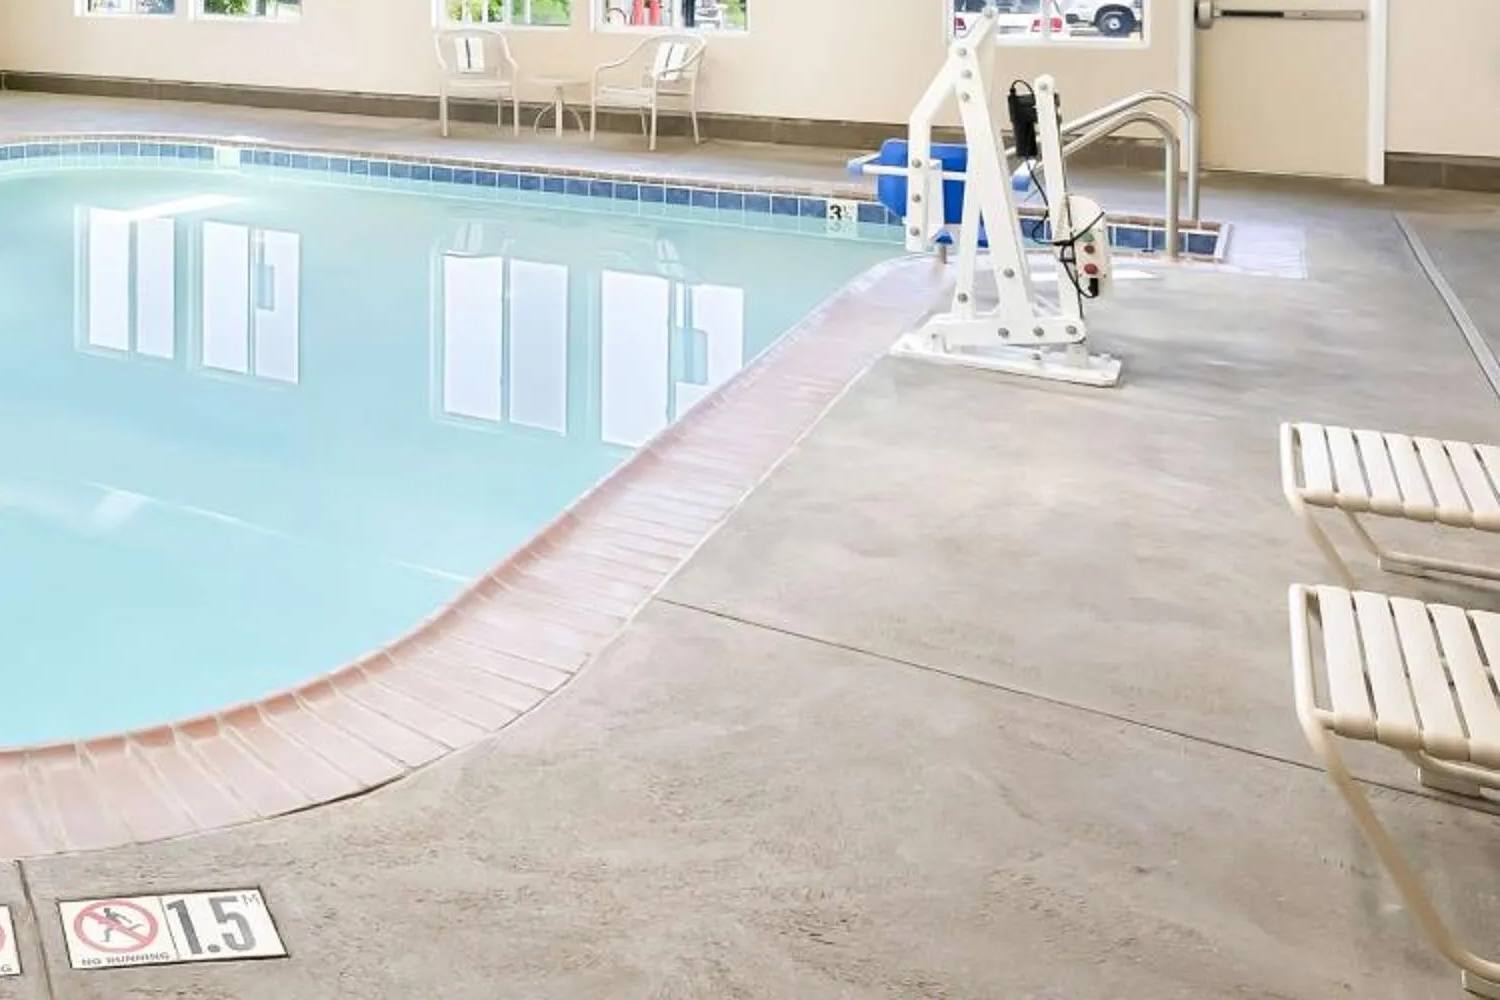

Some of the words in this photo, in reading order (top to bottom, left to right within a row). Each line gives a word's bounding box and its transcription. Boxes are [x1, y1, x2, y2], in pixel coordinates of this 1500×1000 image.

[830, 204, 842, 221] 3
[166, 896, 257, 955] 1.5
[80, 957, 103, 966] NO
[106, 952, 170, 966] RUNNING
